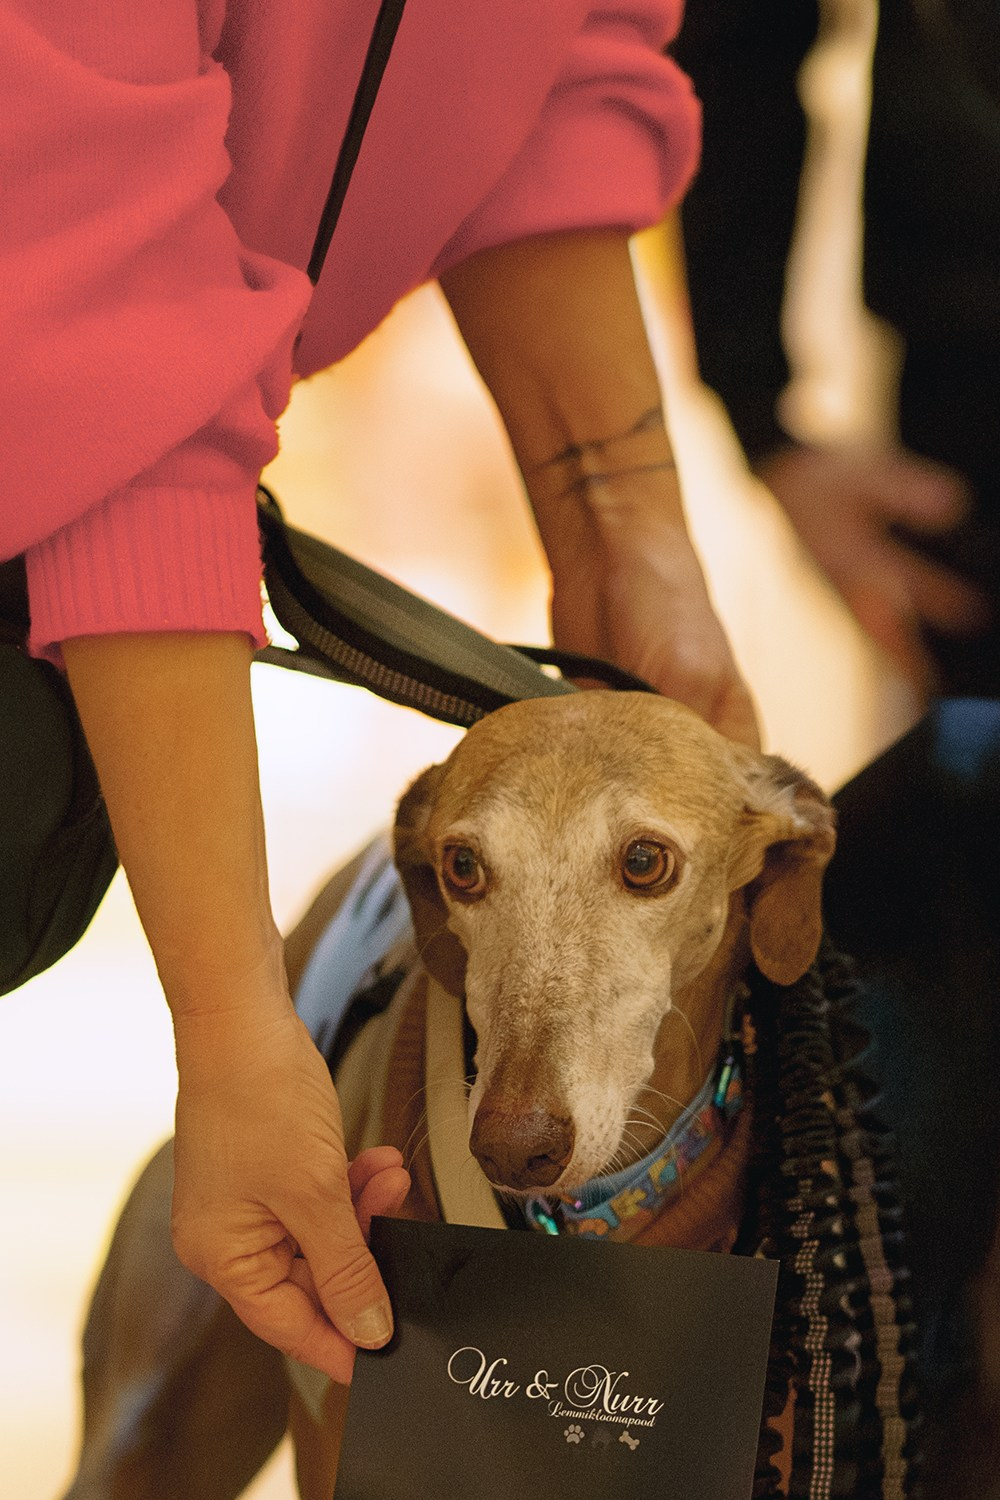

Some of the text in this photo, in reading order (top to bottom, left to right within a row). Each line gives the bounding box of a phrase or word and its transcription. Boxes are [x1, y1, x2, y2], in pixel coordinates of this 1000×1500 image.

[448, 1346, 664, 1415] Urr & Nurr
[548, 1400, 656, 1428] Lemmikloomapood
